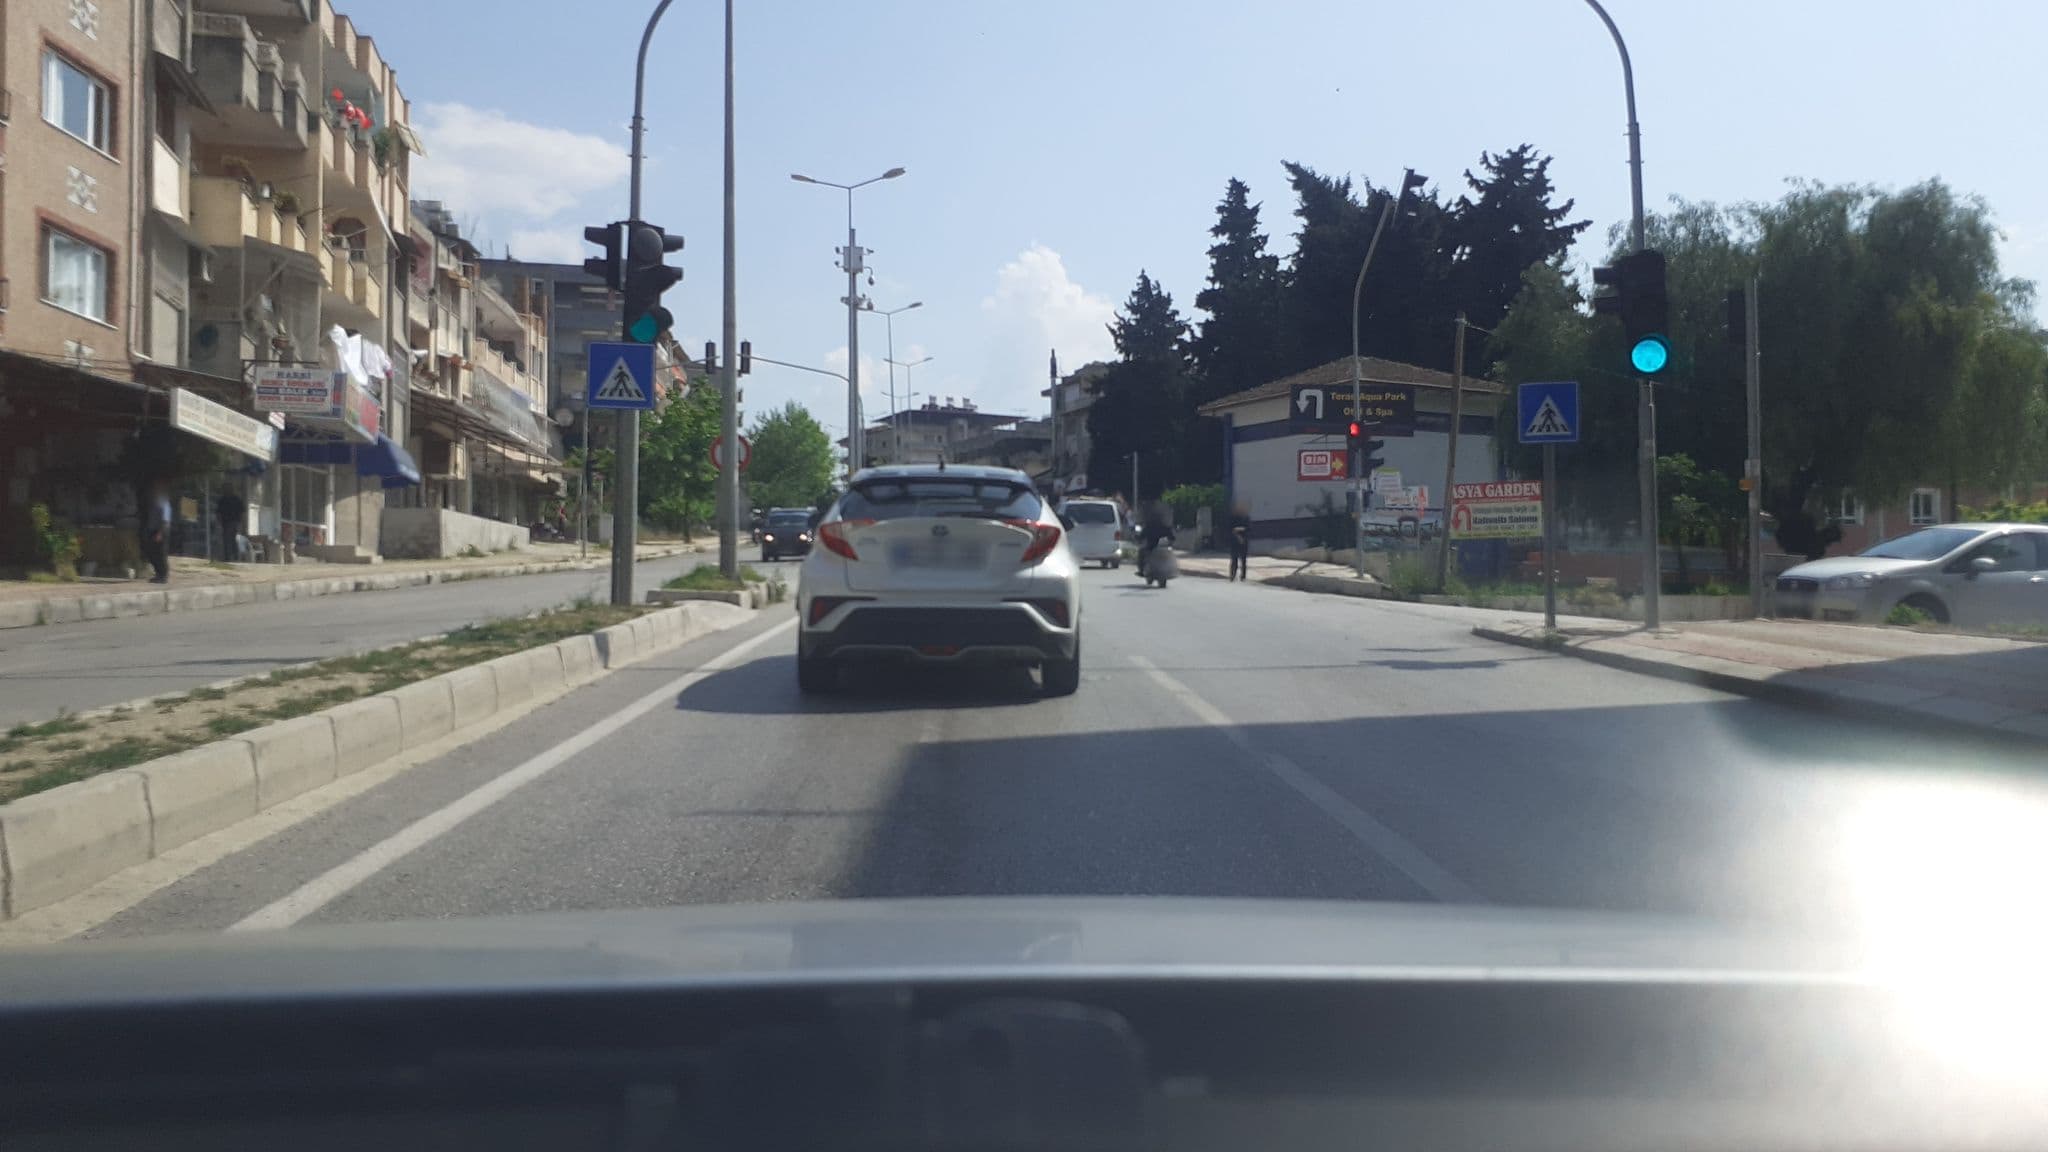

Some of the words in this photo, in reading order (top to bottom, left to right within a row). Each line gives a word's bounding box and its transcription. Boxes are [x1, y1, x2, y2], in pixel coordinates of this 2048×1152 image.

[1359, 392, 1382, 402] Aqua
[1384, 392, 1406, 400] Park
[1343, 407, 1362, 415] Otl
[1375, 408, 1393, 416] Spa
[1485, 482, 1541, 497] GARDEN
